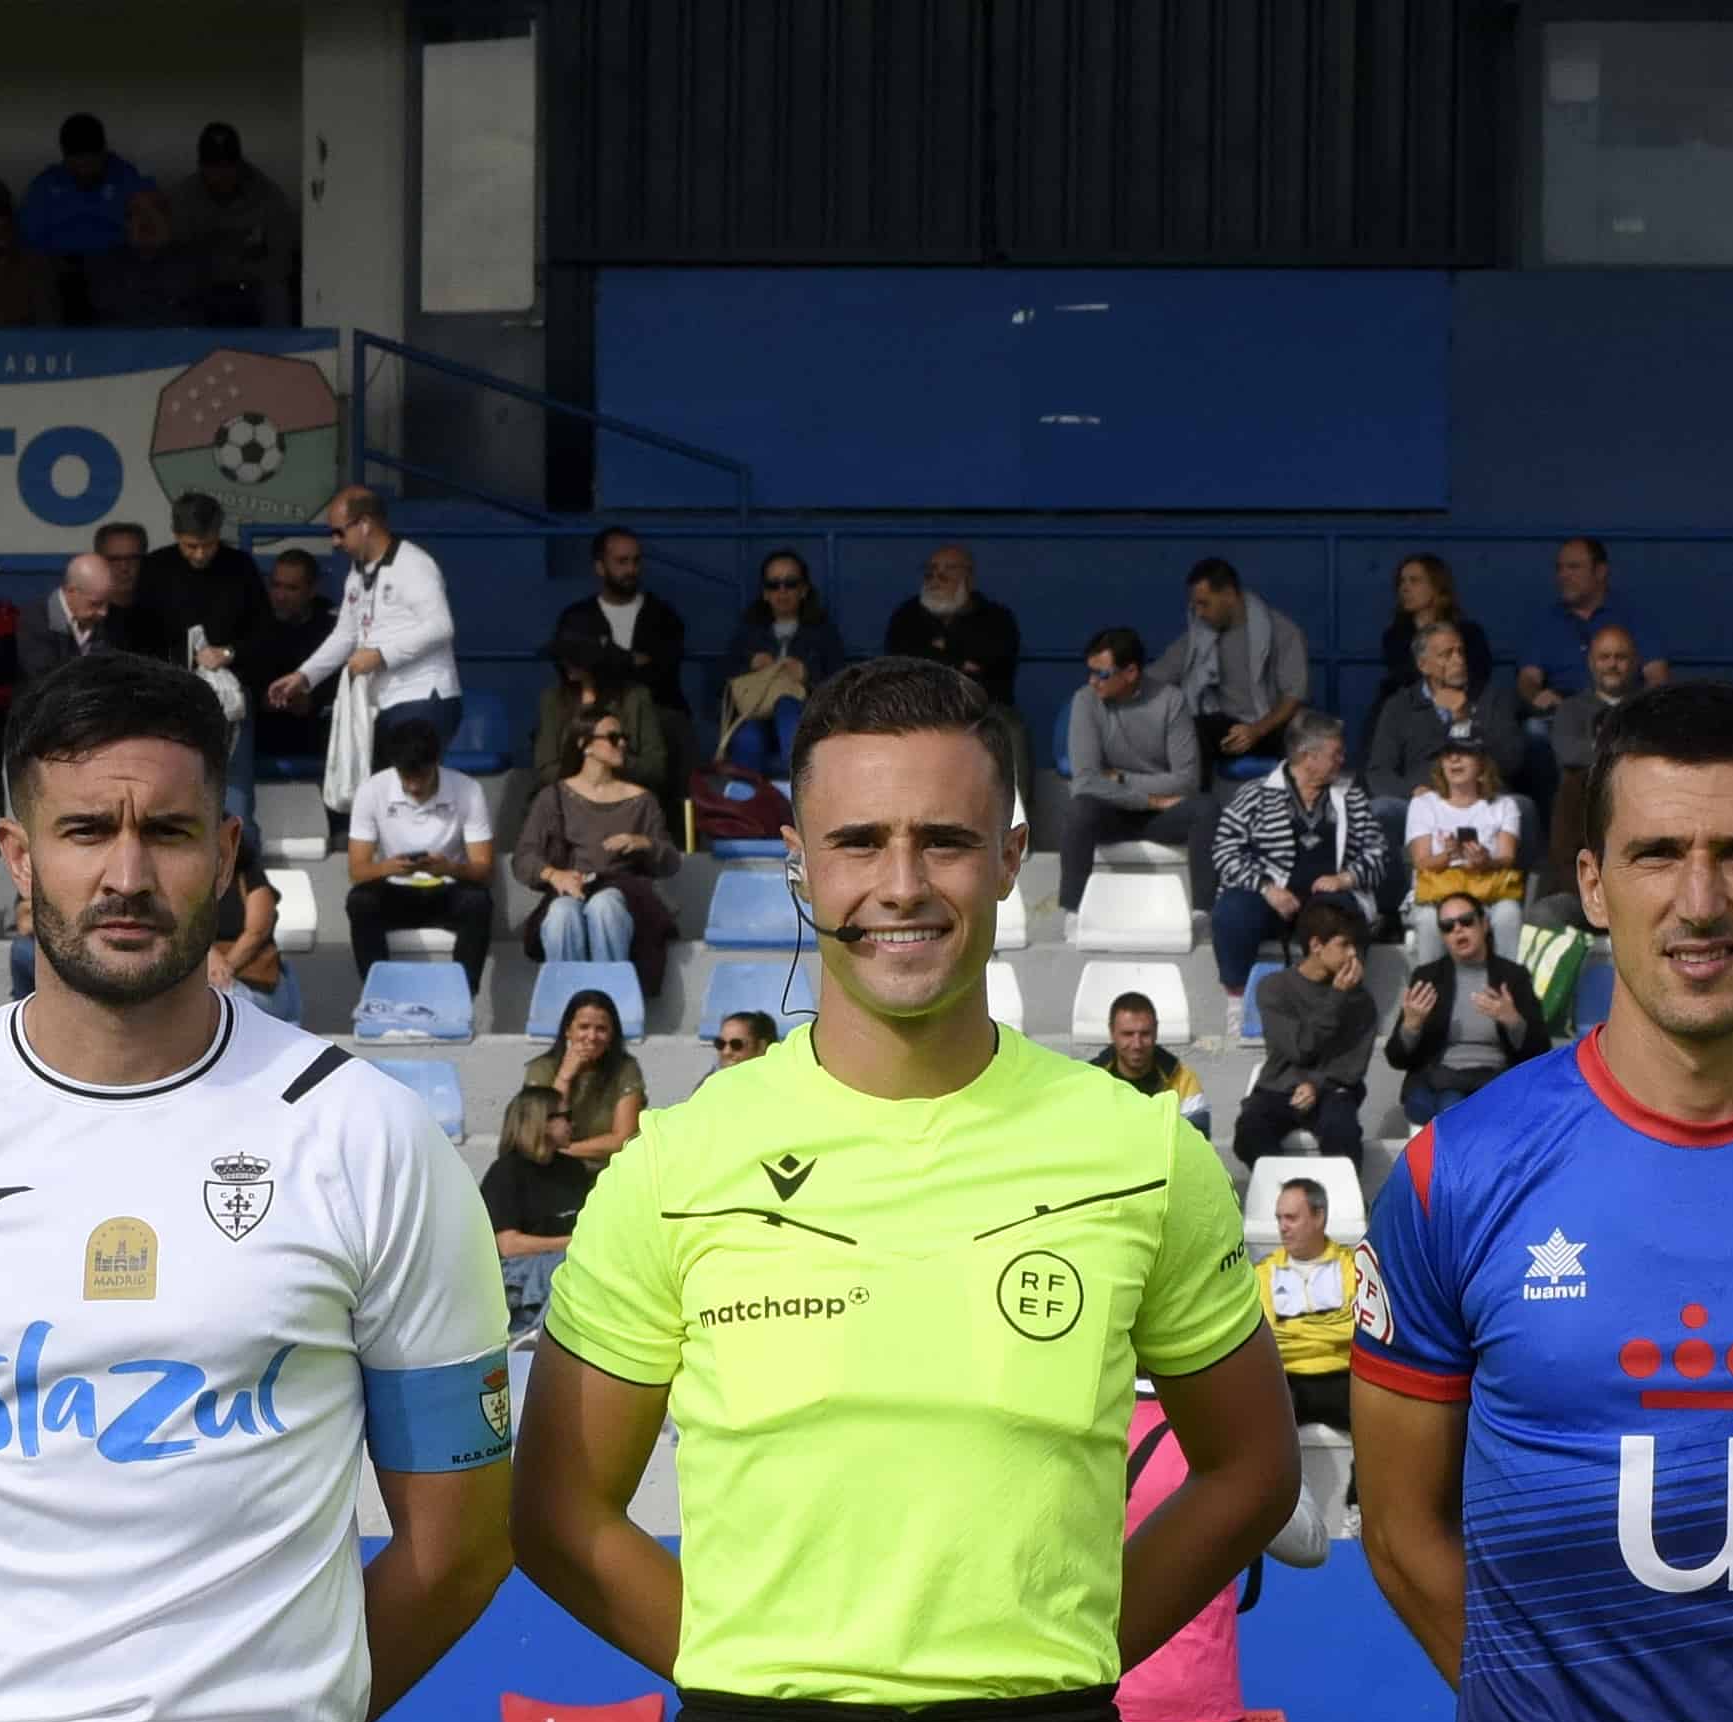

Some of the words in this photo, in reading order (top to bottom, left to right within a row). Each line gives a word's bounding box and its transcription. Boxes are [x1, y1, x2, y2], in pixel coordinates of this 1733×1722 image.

[93, 1274, 147, 1287] MADRID
[1523, 1281, 1587, 1300] luanvi
[699, 1296, 845, 1328] matchapp
